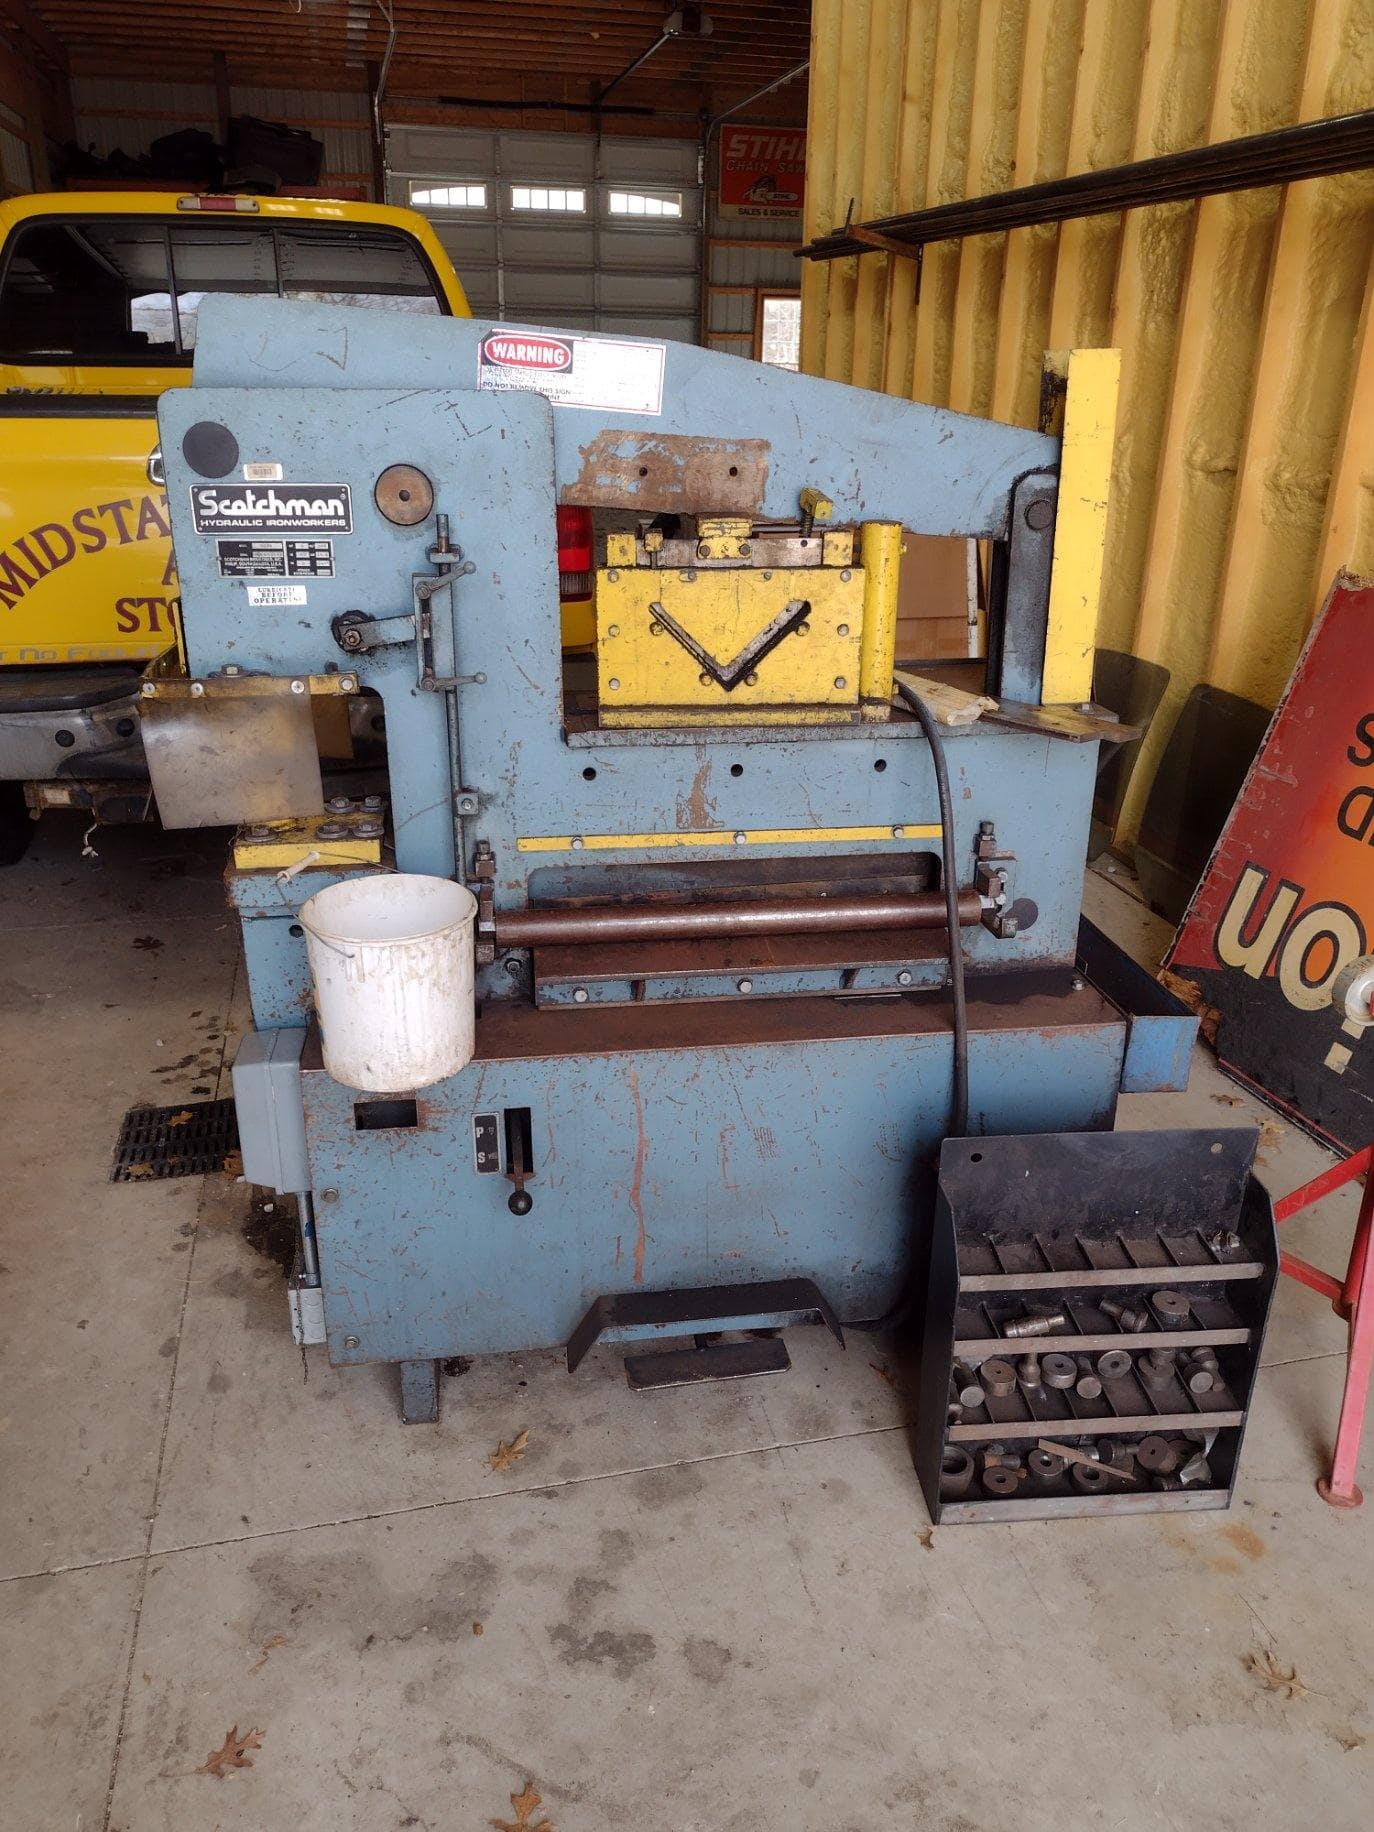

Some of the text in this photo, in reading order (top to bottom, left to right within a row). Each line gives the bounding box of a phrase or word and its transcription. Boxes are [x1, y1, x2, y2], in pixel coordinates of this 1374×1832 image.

[726, 159, 769, 172] CHAIN
[738, 207, 762, 216] SALES
[769, 209, 800, 218] SERVICE
[491, 340, 565, 365] WARNING
[510, 383, 537, 392] REMOVE
[198, 489, 345, 516] Scotchman
[199, 519, 263, 527] HYDRAULIC
[0, 494, 172, 610] MIDSTA
[1336, 785, 1374, 847] D
[476, 1127, 484, 1138] P
[478, 1152, 485, 1164] S
